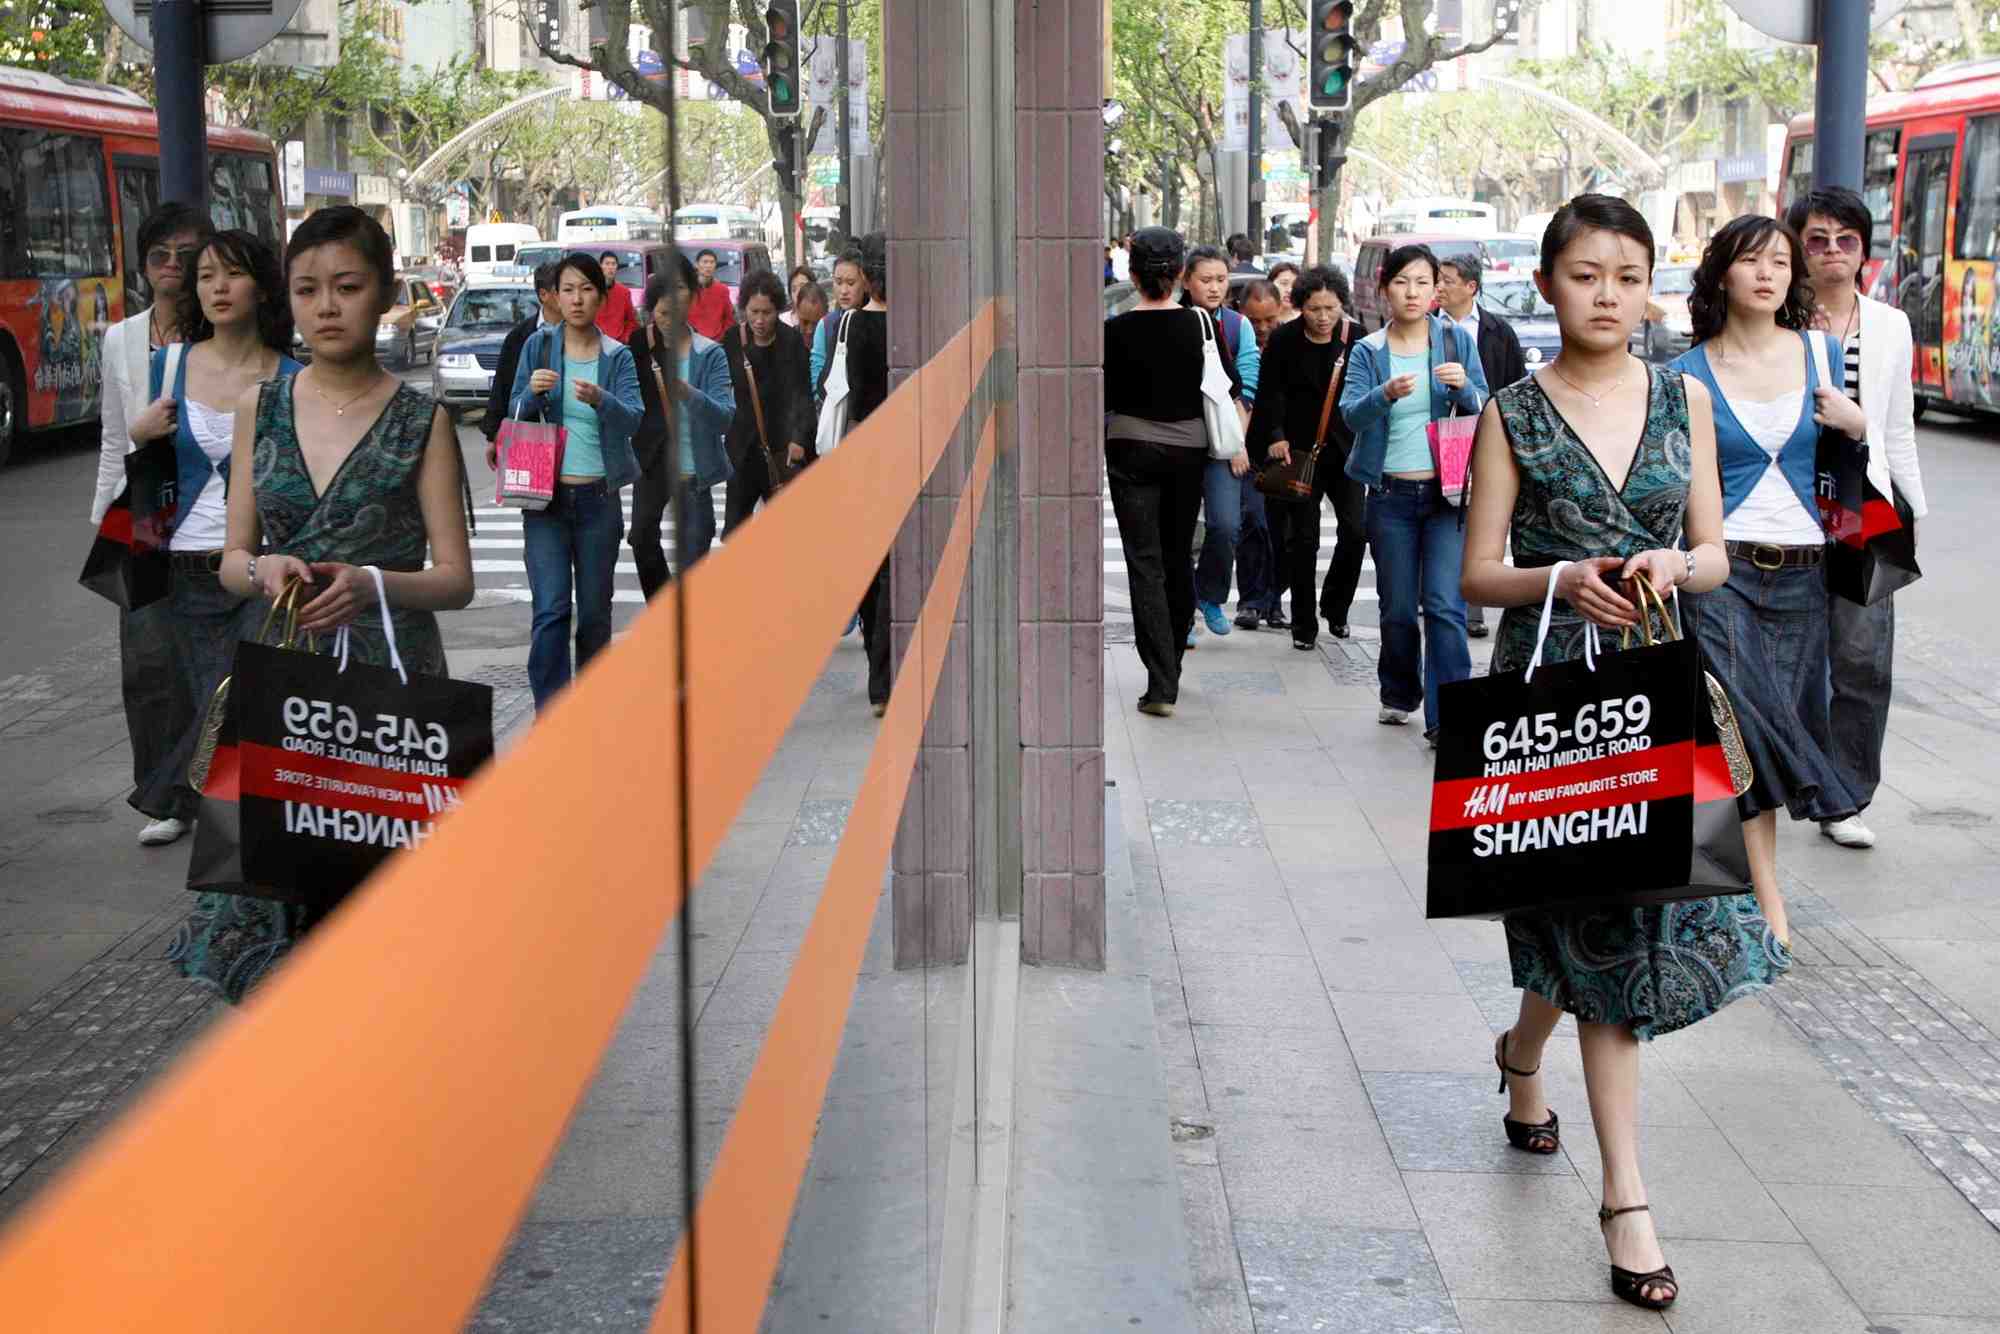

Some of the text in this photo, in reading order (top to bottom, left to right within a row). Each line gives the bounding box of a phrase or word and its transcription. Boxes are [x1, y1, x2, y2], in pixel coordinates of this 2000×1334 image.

[1483, 694, 1651, 761] 645-659
[1483, 735, 1651, 778] HUAI HAI MIDDLE ROAD
[1463, 769, 1659, 818] H&M MY NEW FAVOURITE STORE
[1472, 800, 1649, 857] SHANGHAI
